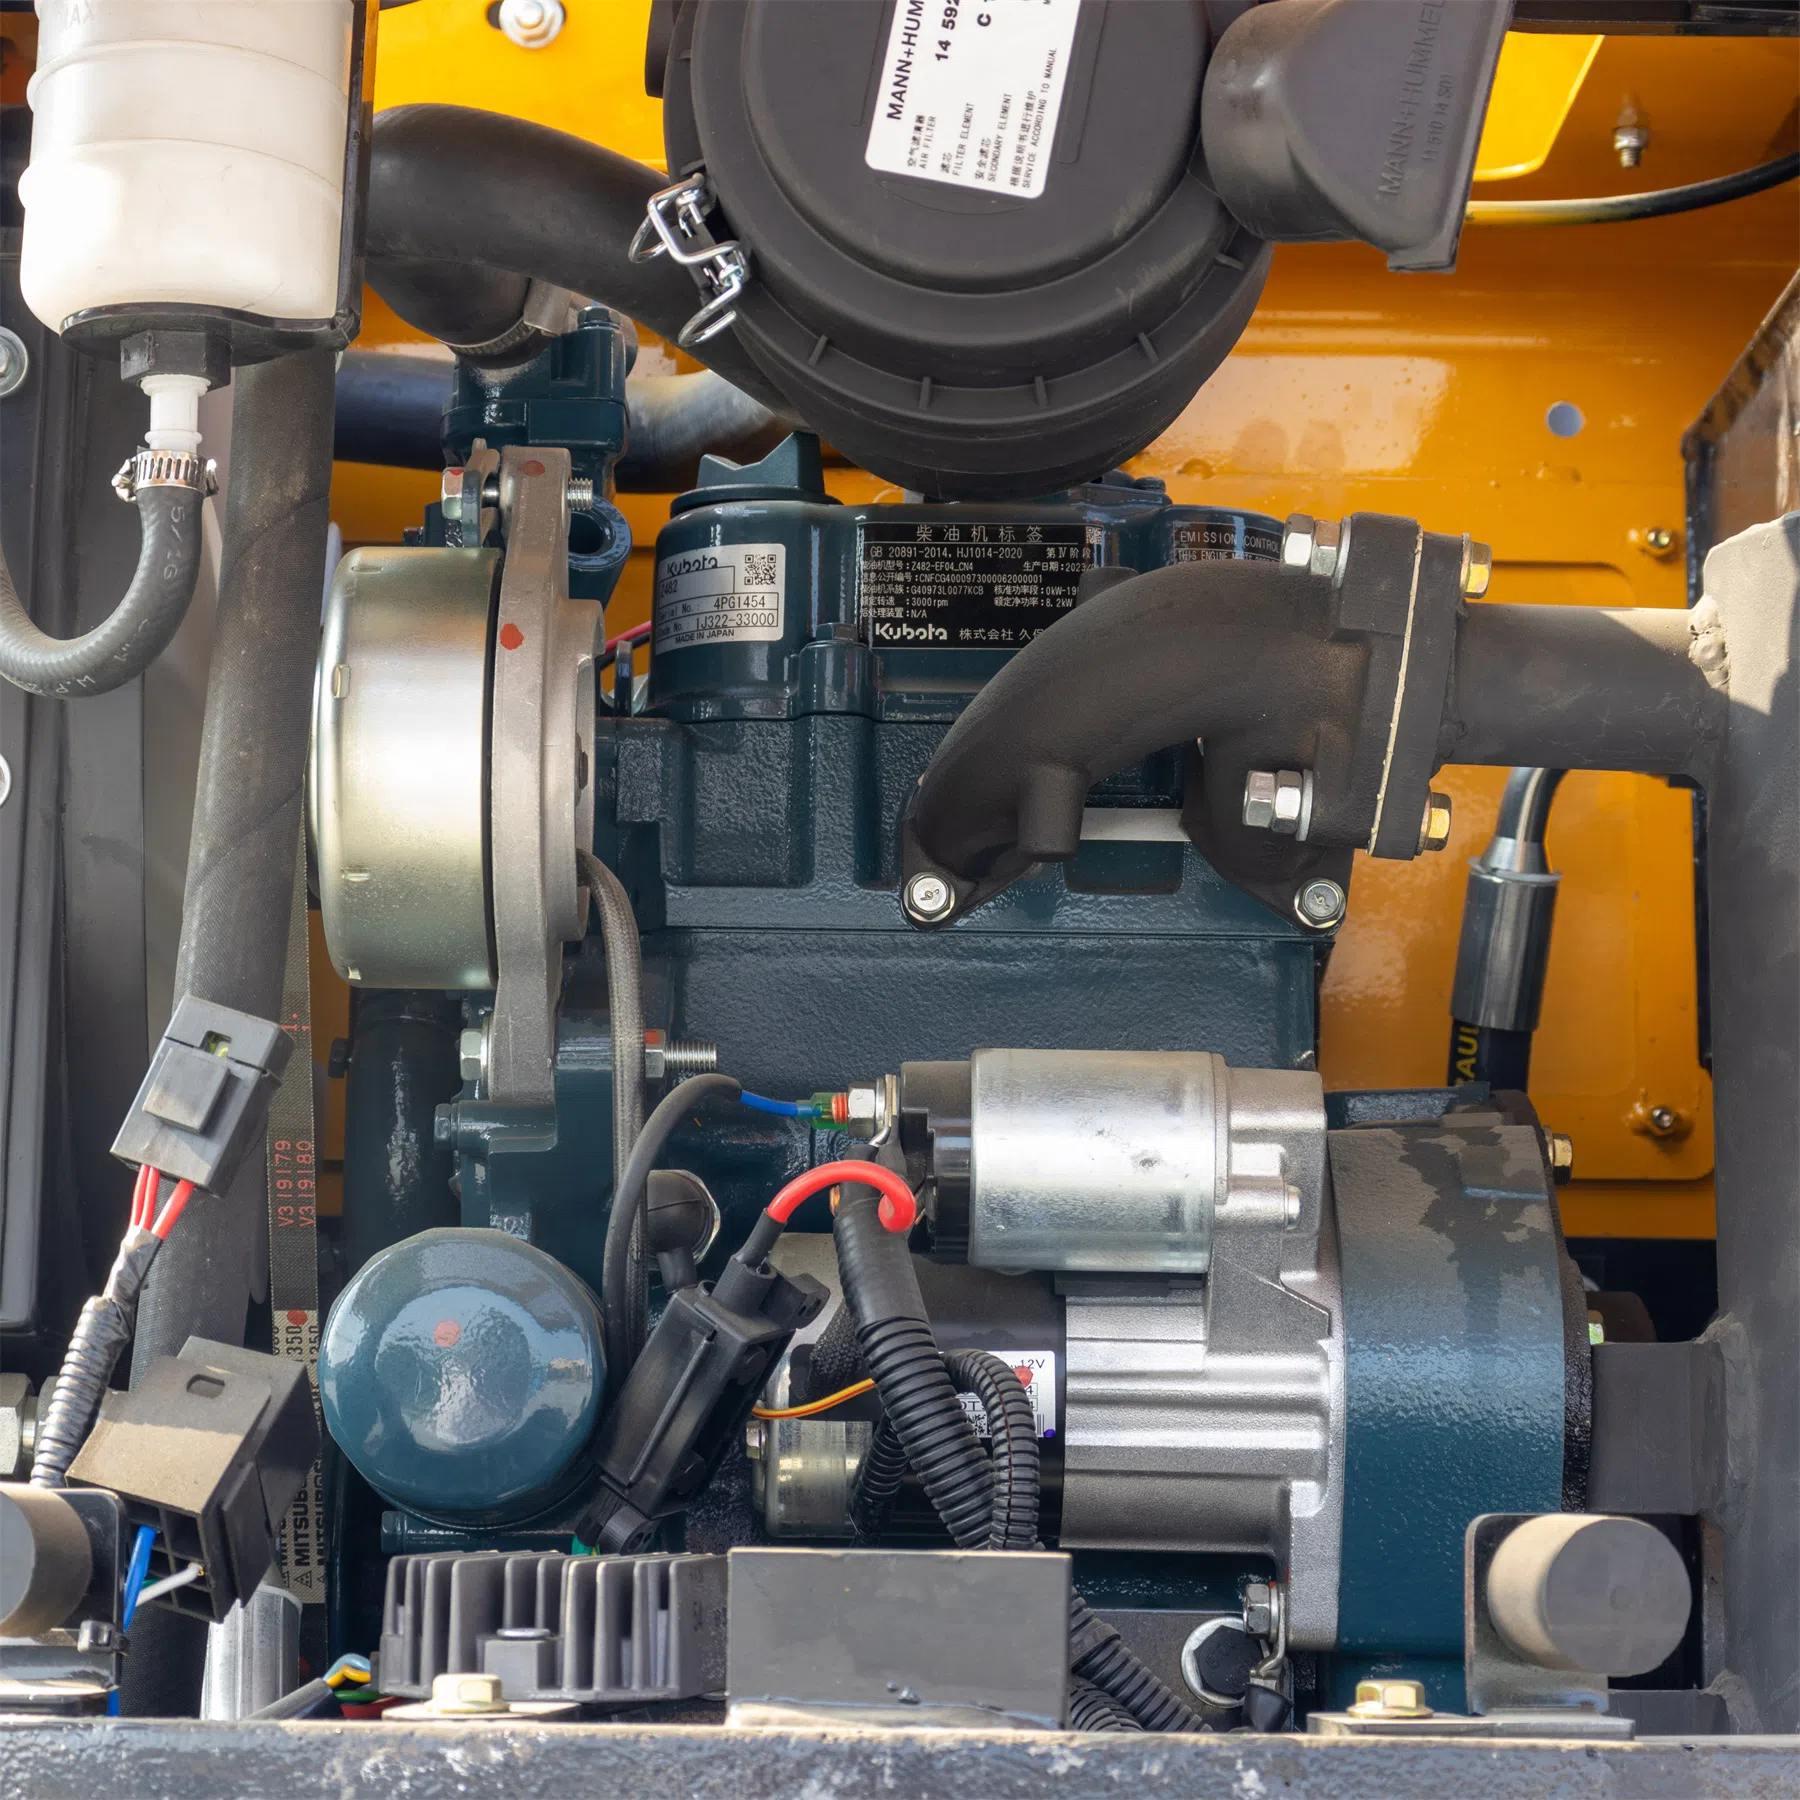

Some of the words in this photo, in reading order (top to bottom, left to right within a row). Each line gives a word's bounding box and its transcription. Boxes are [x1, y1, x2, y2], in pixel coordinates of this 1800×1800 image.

[977, 13, 991, 27] C
[935, 40, 951, 61] 14
[1043, 48, 1058, 79] MANUAL
[1040, 83, 1050, 94] TO
[923, 116, 936, 149] FILTER
[1031, 99, 1048, 147] ACCORDING
[907, 114, 925, 167] 空气滤清器
[953, 143, 967, 176] FILTER
[960, 102, 975, 140] ELEMENT
[987, 135, 1004, 182] SECONDARY
[998, 93, 1013, 130] ELEMENT
[919, 150, 929, 169] AIR
[941, 152, 952, 173] 滤芯
[975, 138, 991, 180] 安全滤芯
[1022, 151, 1036, 188] SERVICE
[916, 525, 1043, 543] 柴油机标签
[1180, 531, 1237, 545] EMISSION
[1244, 535, 1280, 554] CONTROL
[870, 547, 882, 558] GB
[957, 547, 1023, 559] HJ1014-2020
[713, 595, 766, 610] 4PG1454
[675, 633, 694, 643] MADE
[697, 631, 705, 639] IN
[707, 629, 734, 638] JAPAN
[875, 623, 948, 640] Kubota
[959, 628, 1014, 641] 株式会社
[275, 1140, 294, 1227] V319179
[296, 1140, 315, 1227] V319180
